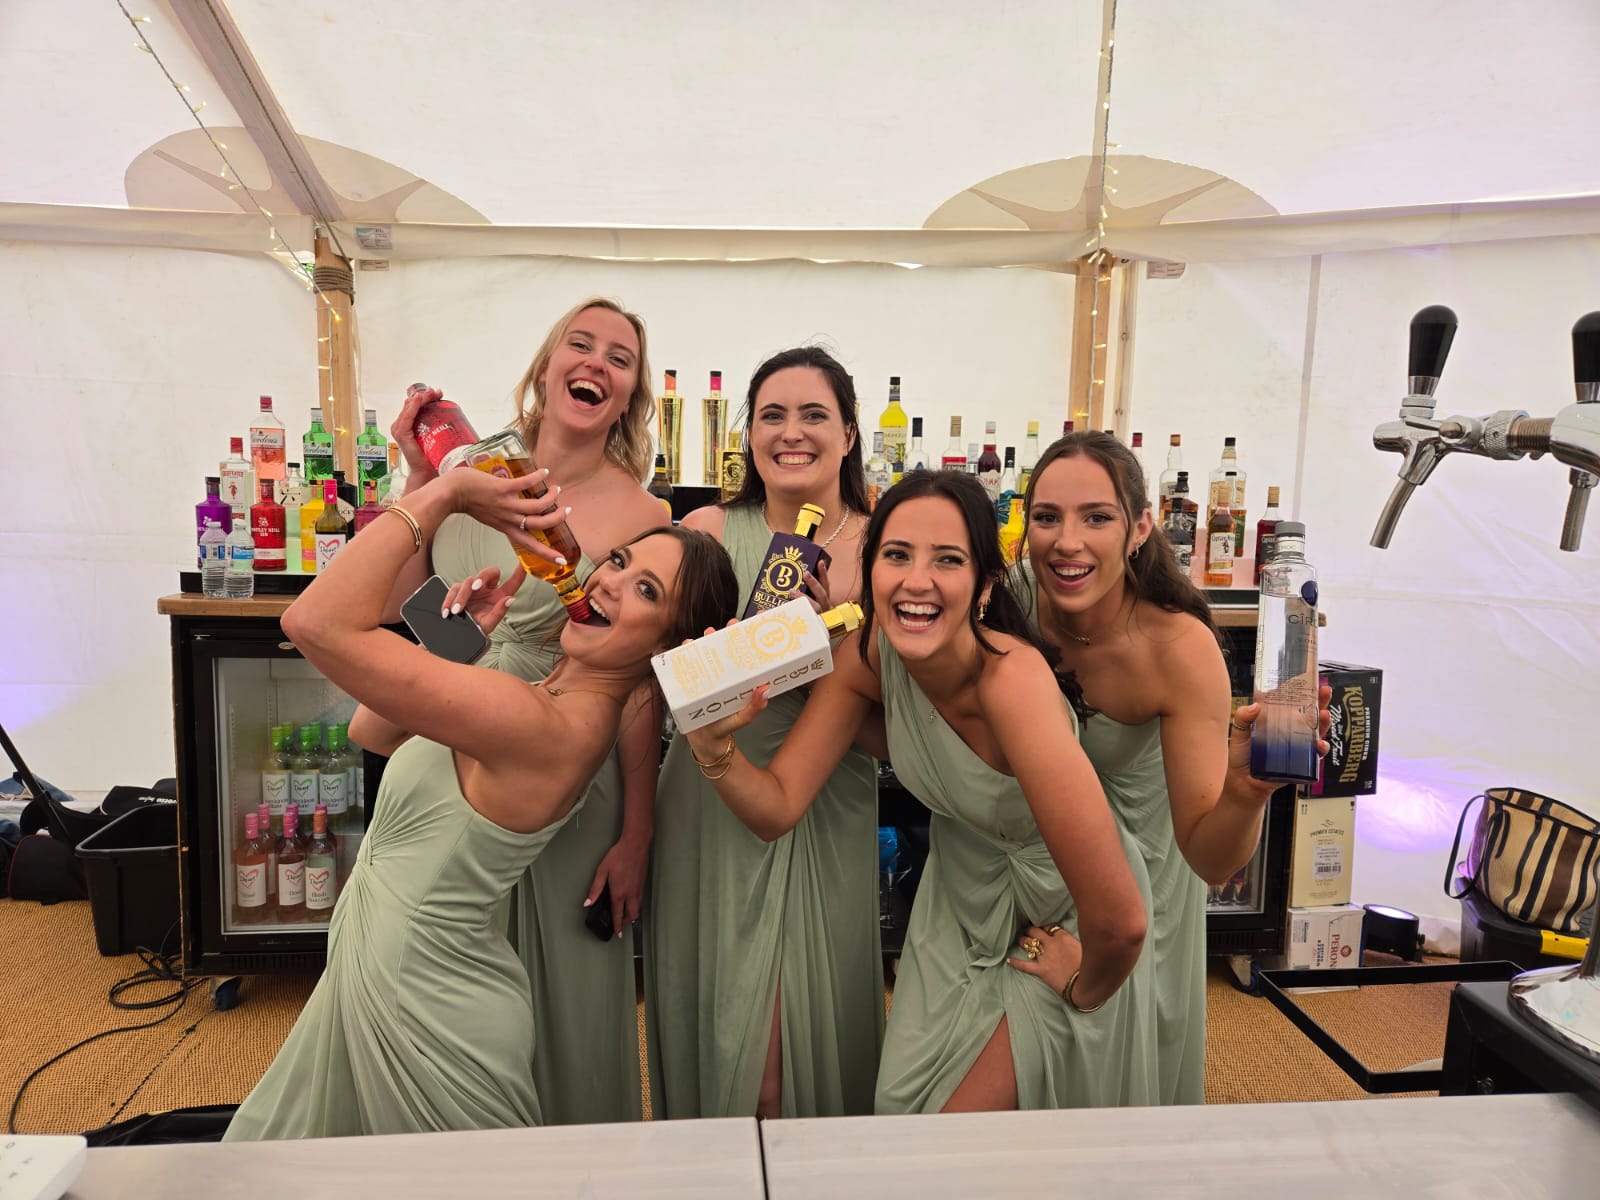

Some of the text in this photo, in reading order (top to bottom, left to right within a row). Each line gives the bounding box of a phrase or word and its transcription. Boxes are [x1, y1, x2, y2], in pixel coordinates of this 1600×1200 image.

[776, 564, 793, 588] B
[753, 591, 786, 607] BULLI
[1339, 686, 1365, 783] KOPPARBERG
[1331, 738, 1343, 766] Fruit
[1362, 740, 1370, 761] CIDER
[1330, 933, 1341, 969] PERON
